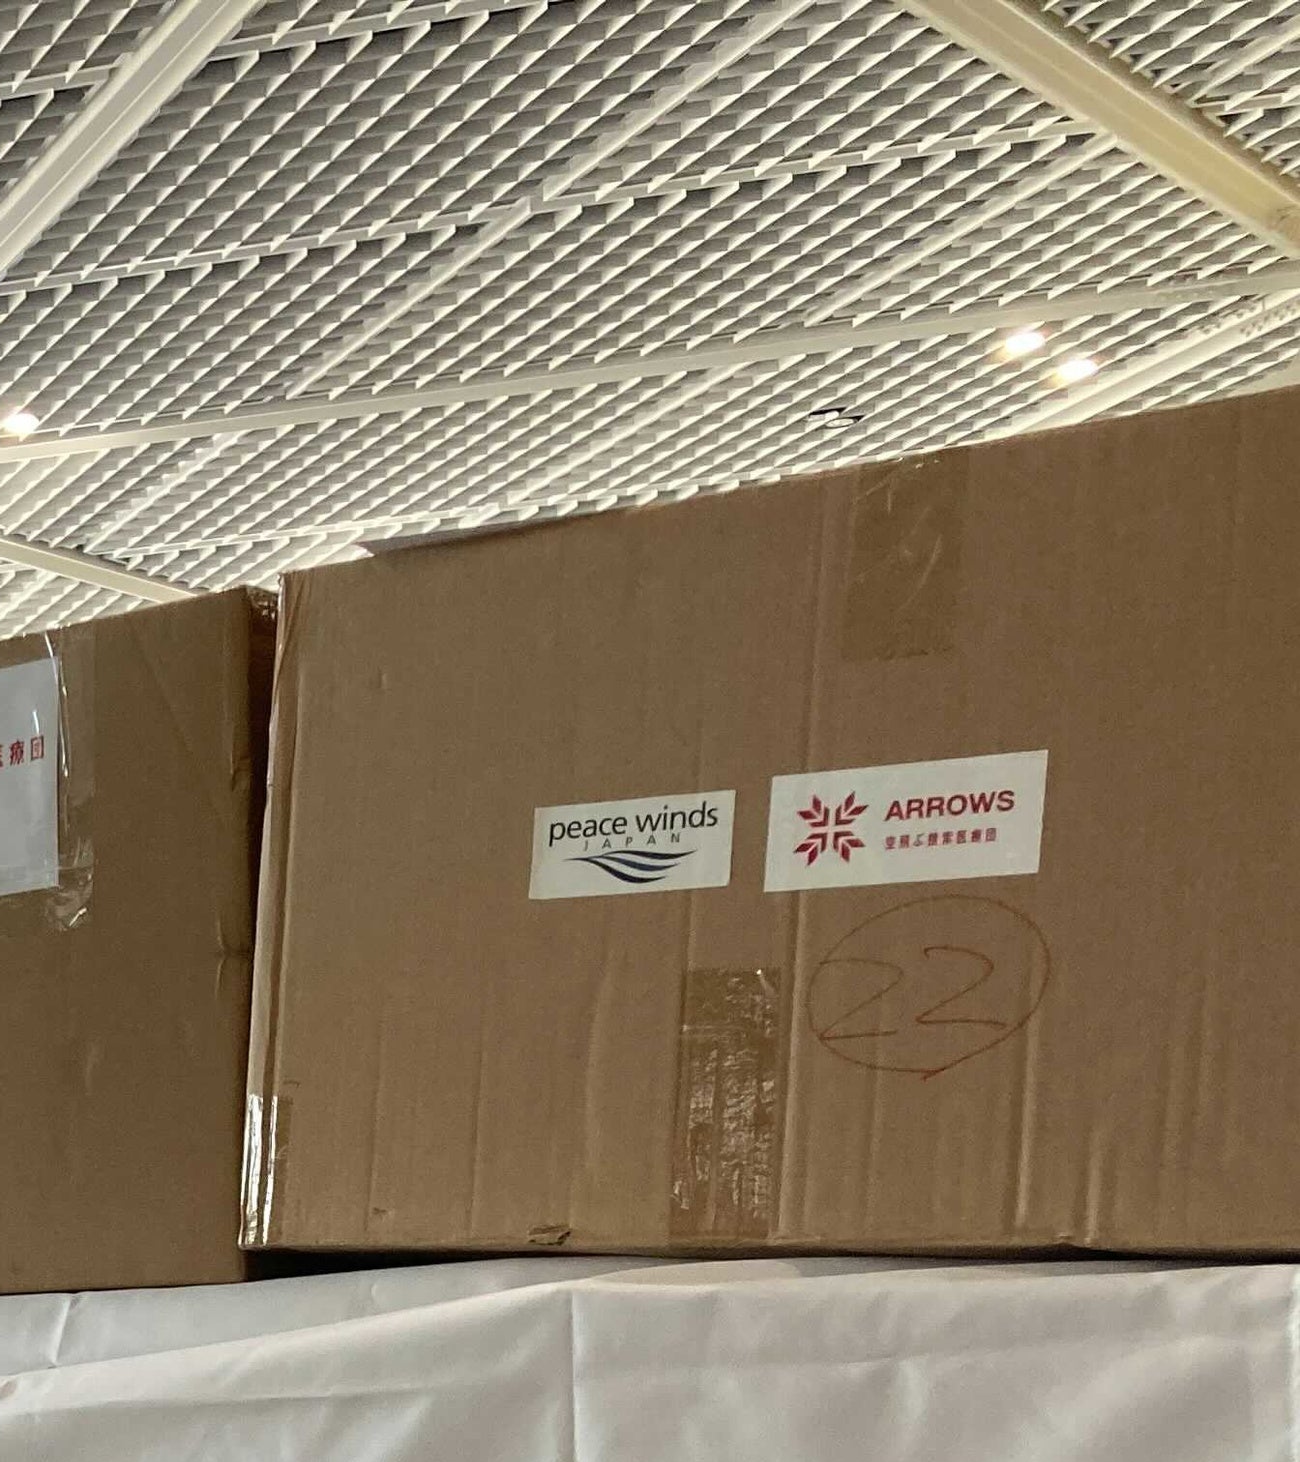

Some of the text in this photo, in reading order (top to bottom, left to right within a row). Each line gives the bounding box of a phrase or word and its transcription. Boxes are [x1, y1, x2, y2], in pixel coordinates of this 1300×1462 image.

[548, 800, 719, 847] peace winds
[883, 789, 1016, 822] ARROWS
[584, 832, 681, 851] JAPAN
[819, 945, 1009, 1042] 22
